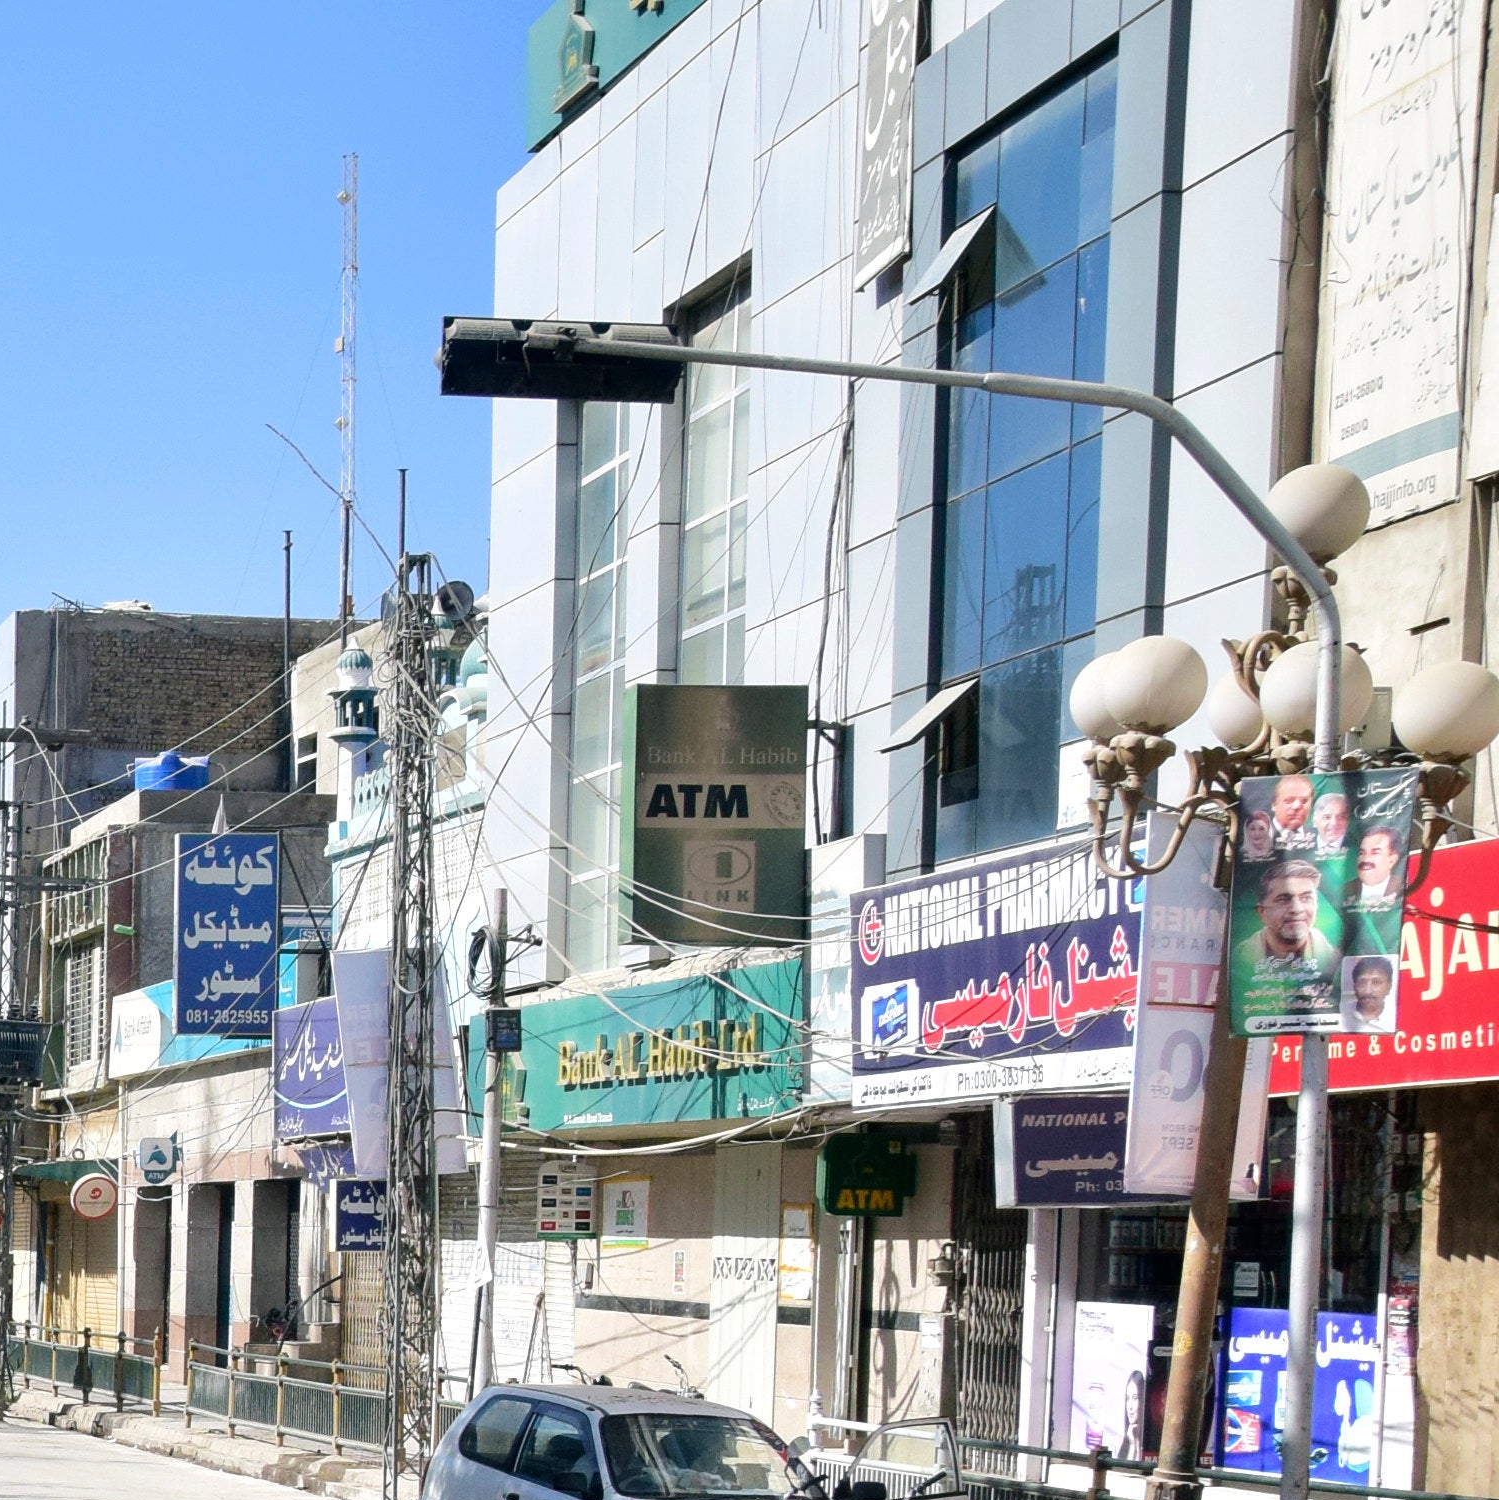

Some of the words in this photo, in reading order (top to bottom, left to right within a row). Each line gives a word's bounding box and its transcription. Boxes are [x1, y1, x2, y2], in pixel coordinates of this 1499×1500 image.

[647, 747, 697, 764] Bank
[741, 748, 798, 765] Habib
[646, 784, 749, 818] ATM
[185, 845, 275, 895] کوئٹہ
[686, 889, 749, 902] LINK
[884, 875, 983, 958] NATIONAL
[987, 846, 1123, 938] PHARMACY
[184, 904, 272, 949] میڈیکل
[194, 960, 261, 1002] سٹور
[922, 941, 1052, 1054] فارمیسی
[186, 1009, 269, 1025] 081-2825955
[558, 1034, 609, 1086] Bank
[613, 1032, 644, 1080] AL
[647, 1020, 716, 1075] Habib
[1369, 1036, 1381, 1055] &
[1395, 1023, 1499, 1053] Cosmeti
[1022, 1114, 1108, 1127] NATIONAL
[148, 1173, 164, 1181] ATM
[1075, 1181, 1100, 1193] Ph:
[837, 1189, 895, 1209] ATM
